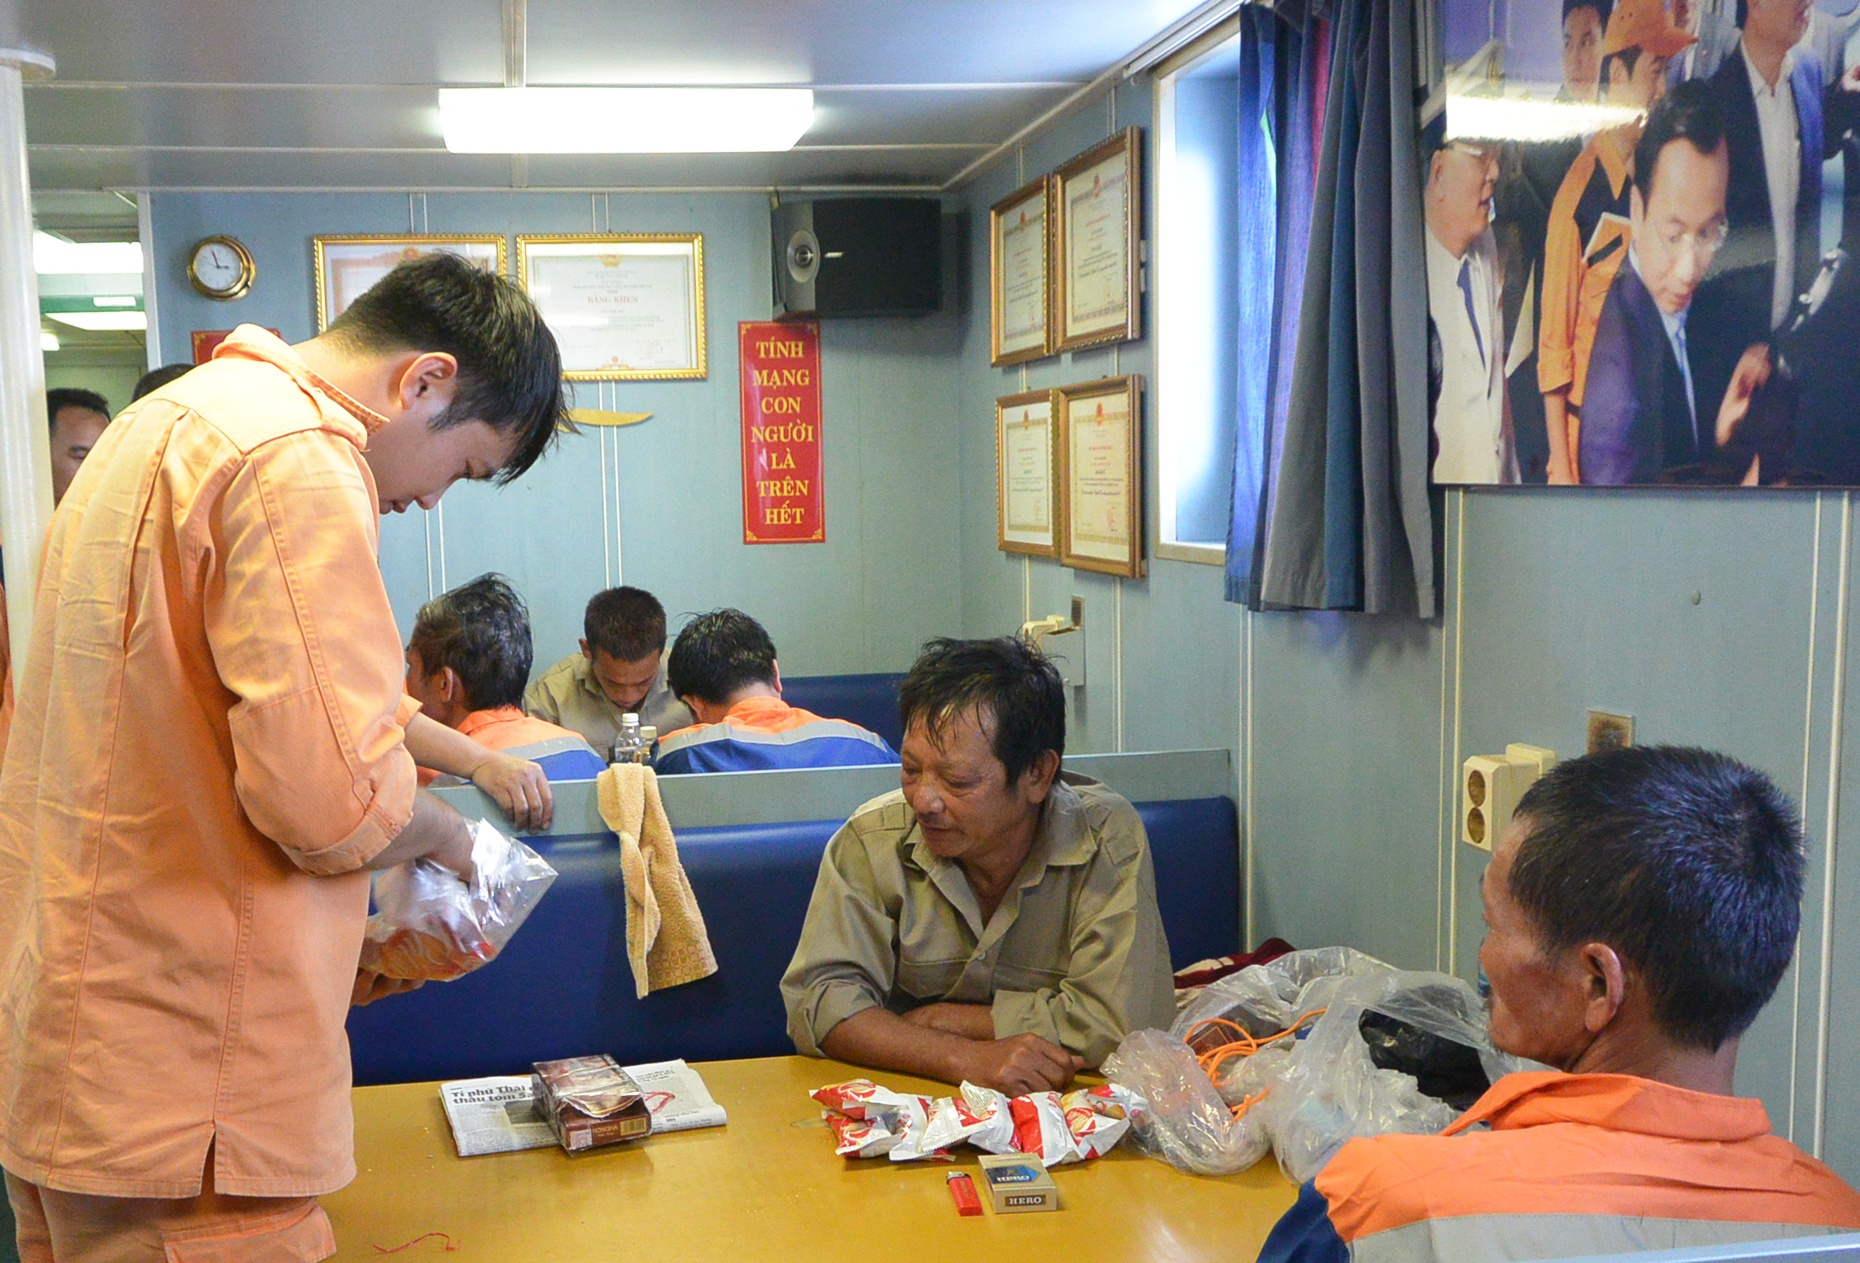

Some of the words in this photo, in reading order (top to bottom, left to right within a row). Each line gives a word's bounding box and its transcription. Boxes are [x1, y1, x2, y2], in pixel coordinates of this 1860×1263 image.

[756, 336, 804, 358] TÍNH
[752, 368, 810, 389] MẠNG
[761, 397, 801, 414] CON
[751, 420, 814, 443] NGƯỜI
[770, 448, 796, 469] LÀ
[756, 475, 809, 497] TRÊN
[764, 501, 805, 524] HẾT
[1009, 1196, 1042, 1205] HERO
